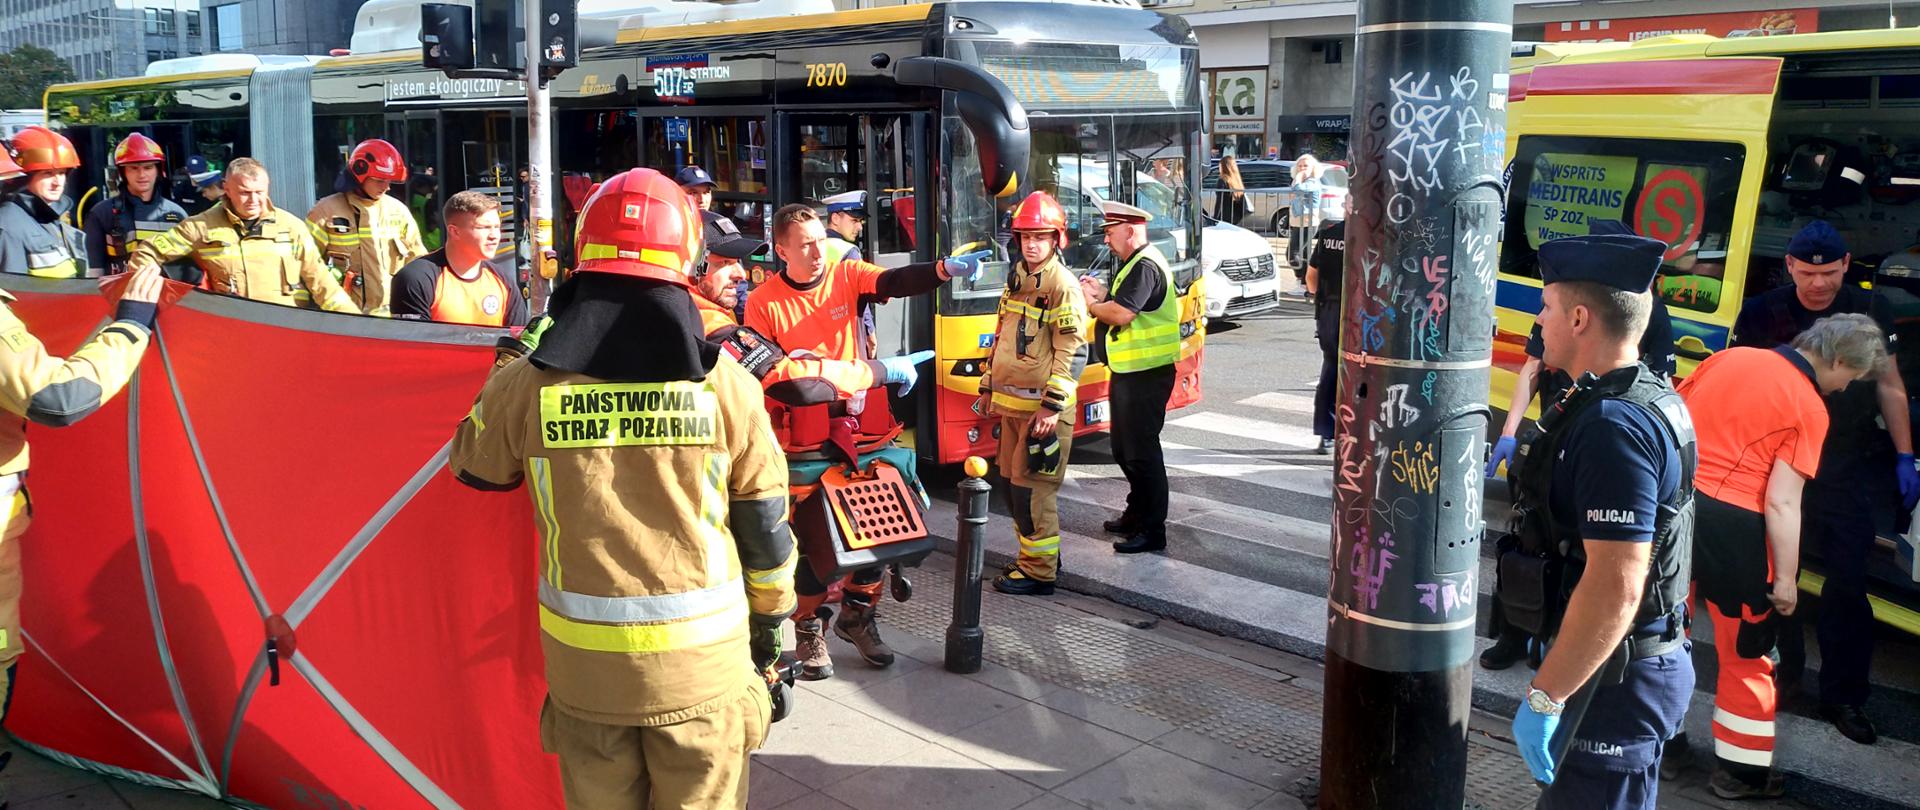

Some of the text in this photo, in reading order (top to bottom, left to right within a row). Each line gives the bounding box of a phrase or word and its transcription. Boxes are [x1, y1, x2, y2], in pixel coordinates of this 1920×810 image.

[653, 67, 683, 97] 507
[690, 66, 730, 79] STATION
[805, 62, 847, 87] 7870
[389, 79, 425, 100] jestem
[429, 77, 500, 98] ekologiczny
[1529, 181, 1623, 209] MEDITRANS
[1544, 206, 1558, 221] SP
[1560, 209, 1584, 225] ZOZ
[1648, 187, 1686, 244] S
[560, 389, 696, 415] PAŃSTWOWA
[1587, 509, 1635, 524] POLICJA
[1571, 737, 1623, 757] POLICJA
